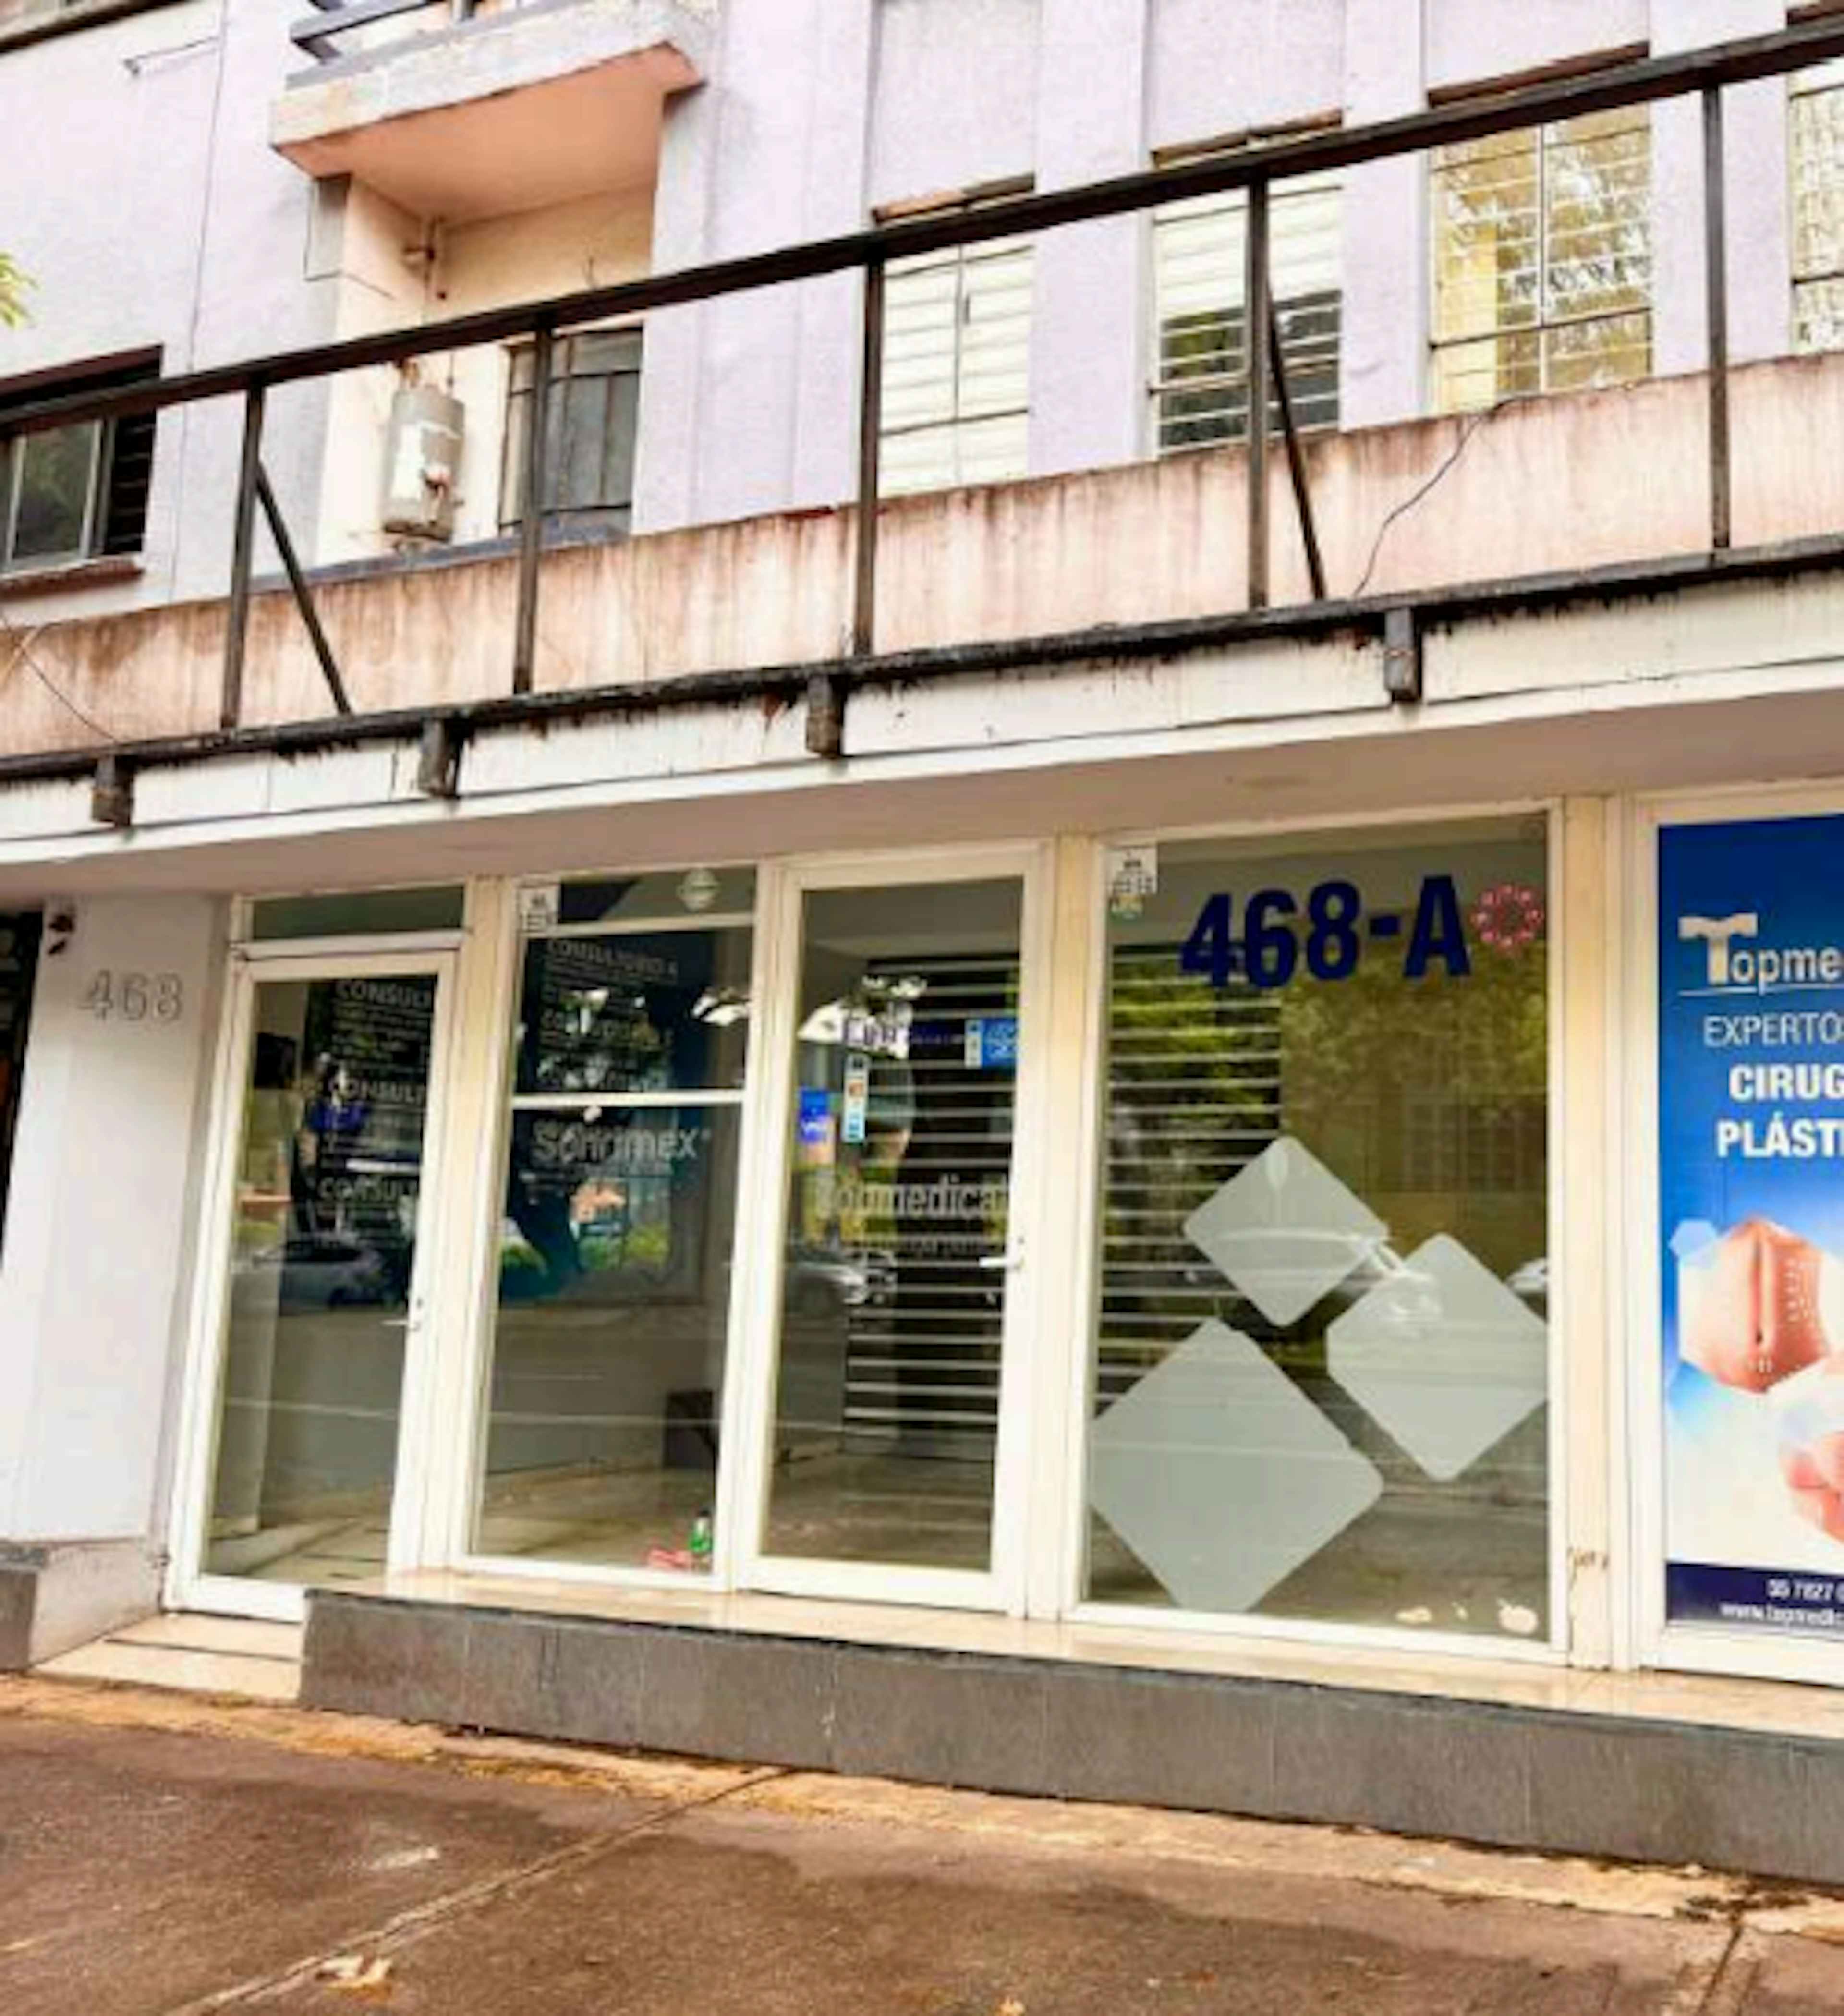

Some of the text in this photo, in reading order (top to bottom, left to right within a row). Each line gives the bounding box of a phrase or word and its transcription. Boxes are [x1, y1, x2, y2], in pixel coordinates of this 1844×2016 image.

[1179, 875, 1470, 988] 468-A
[1678, 913, 1844, 995] Topme
[75, 969, 183, 1023] 468
[1729, 1063, 1844, 1101] CIRUG
